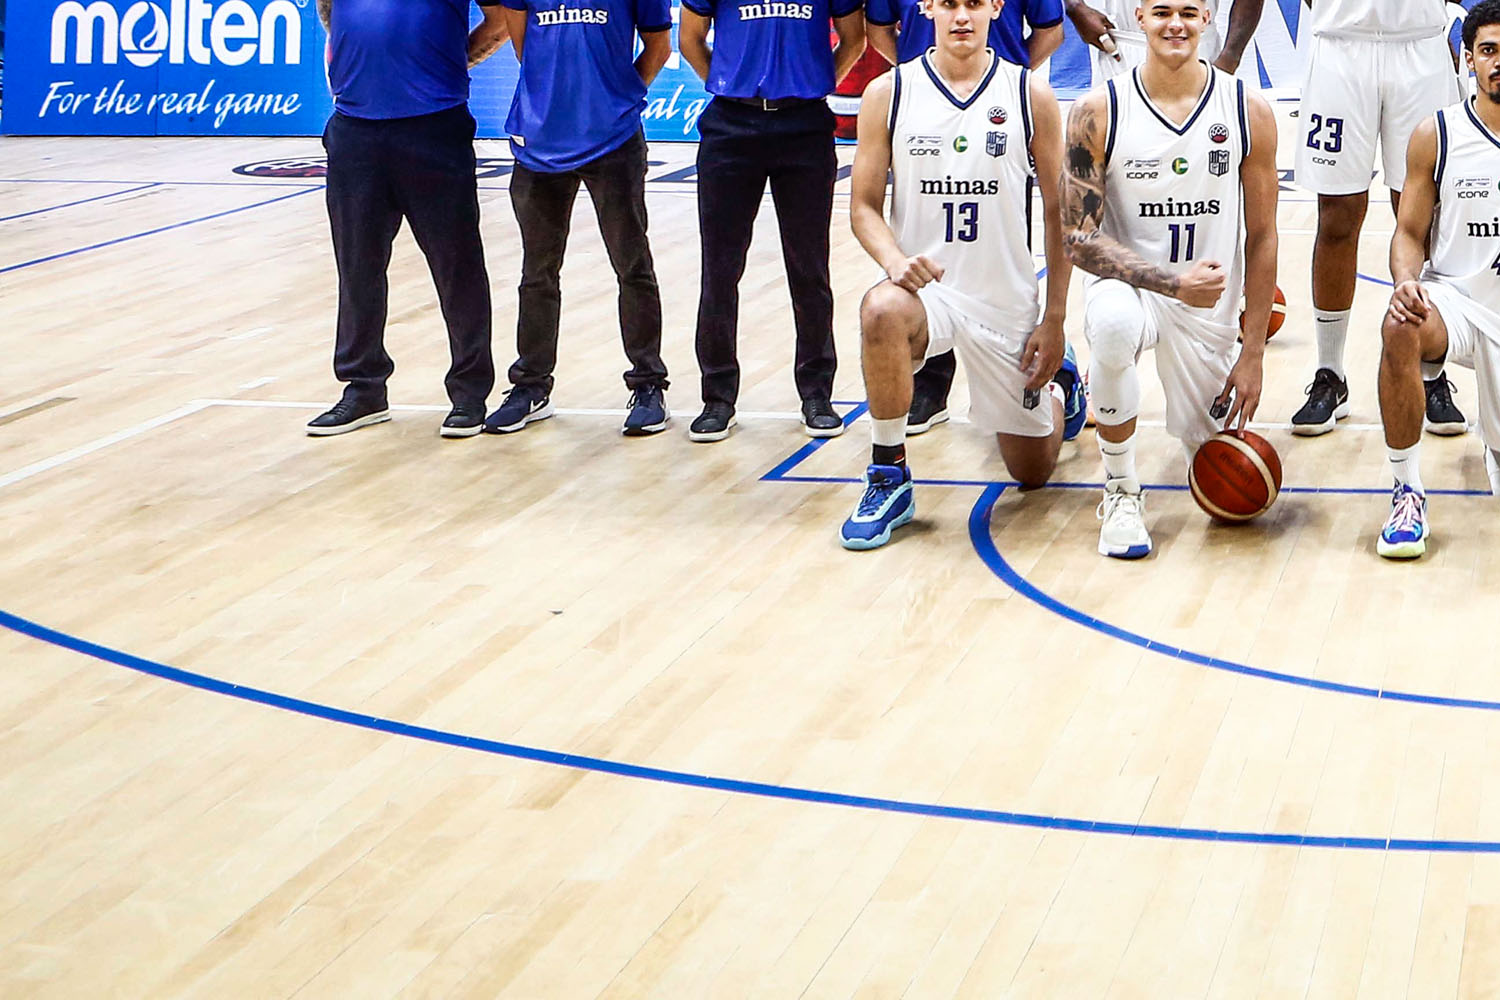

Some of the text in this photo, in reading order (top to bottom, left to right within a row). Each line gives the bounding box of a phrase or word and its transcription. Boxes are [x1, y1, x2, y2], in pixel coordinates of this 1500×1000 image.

[536, 4, 608, 26] minas
[39, 79, 302, 129] For the real game
[1306, 113, 1344, 153] 23
[920, 175, 999, 195] minas
[1126, 171, 1159, 180] icone
[1457, 190, 1489, 198] icone
[1139, 197, 1220, 217] minas
[942, 202, 979, 243] 13
[1168, 223, 1196, 263] 11
